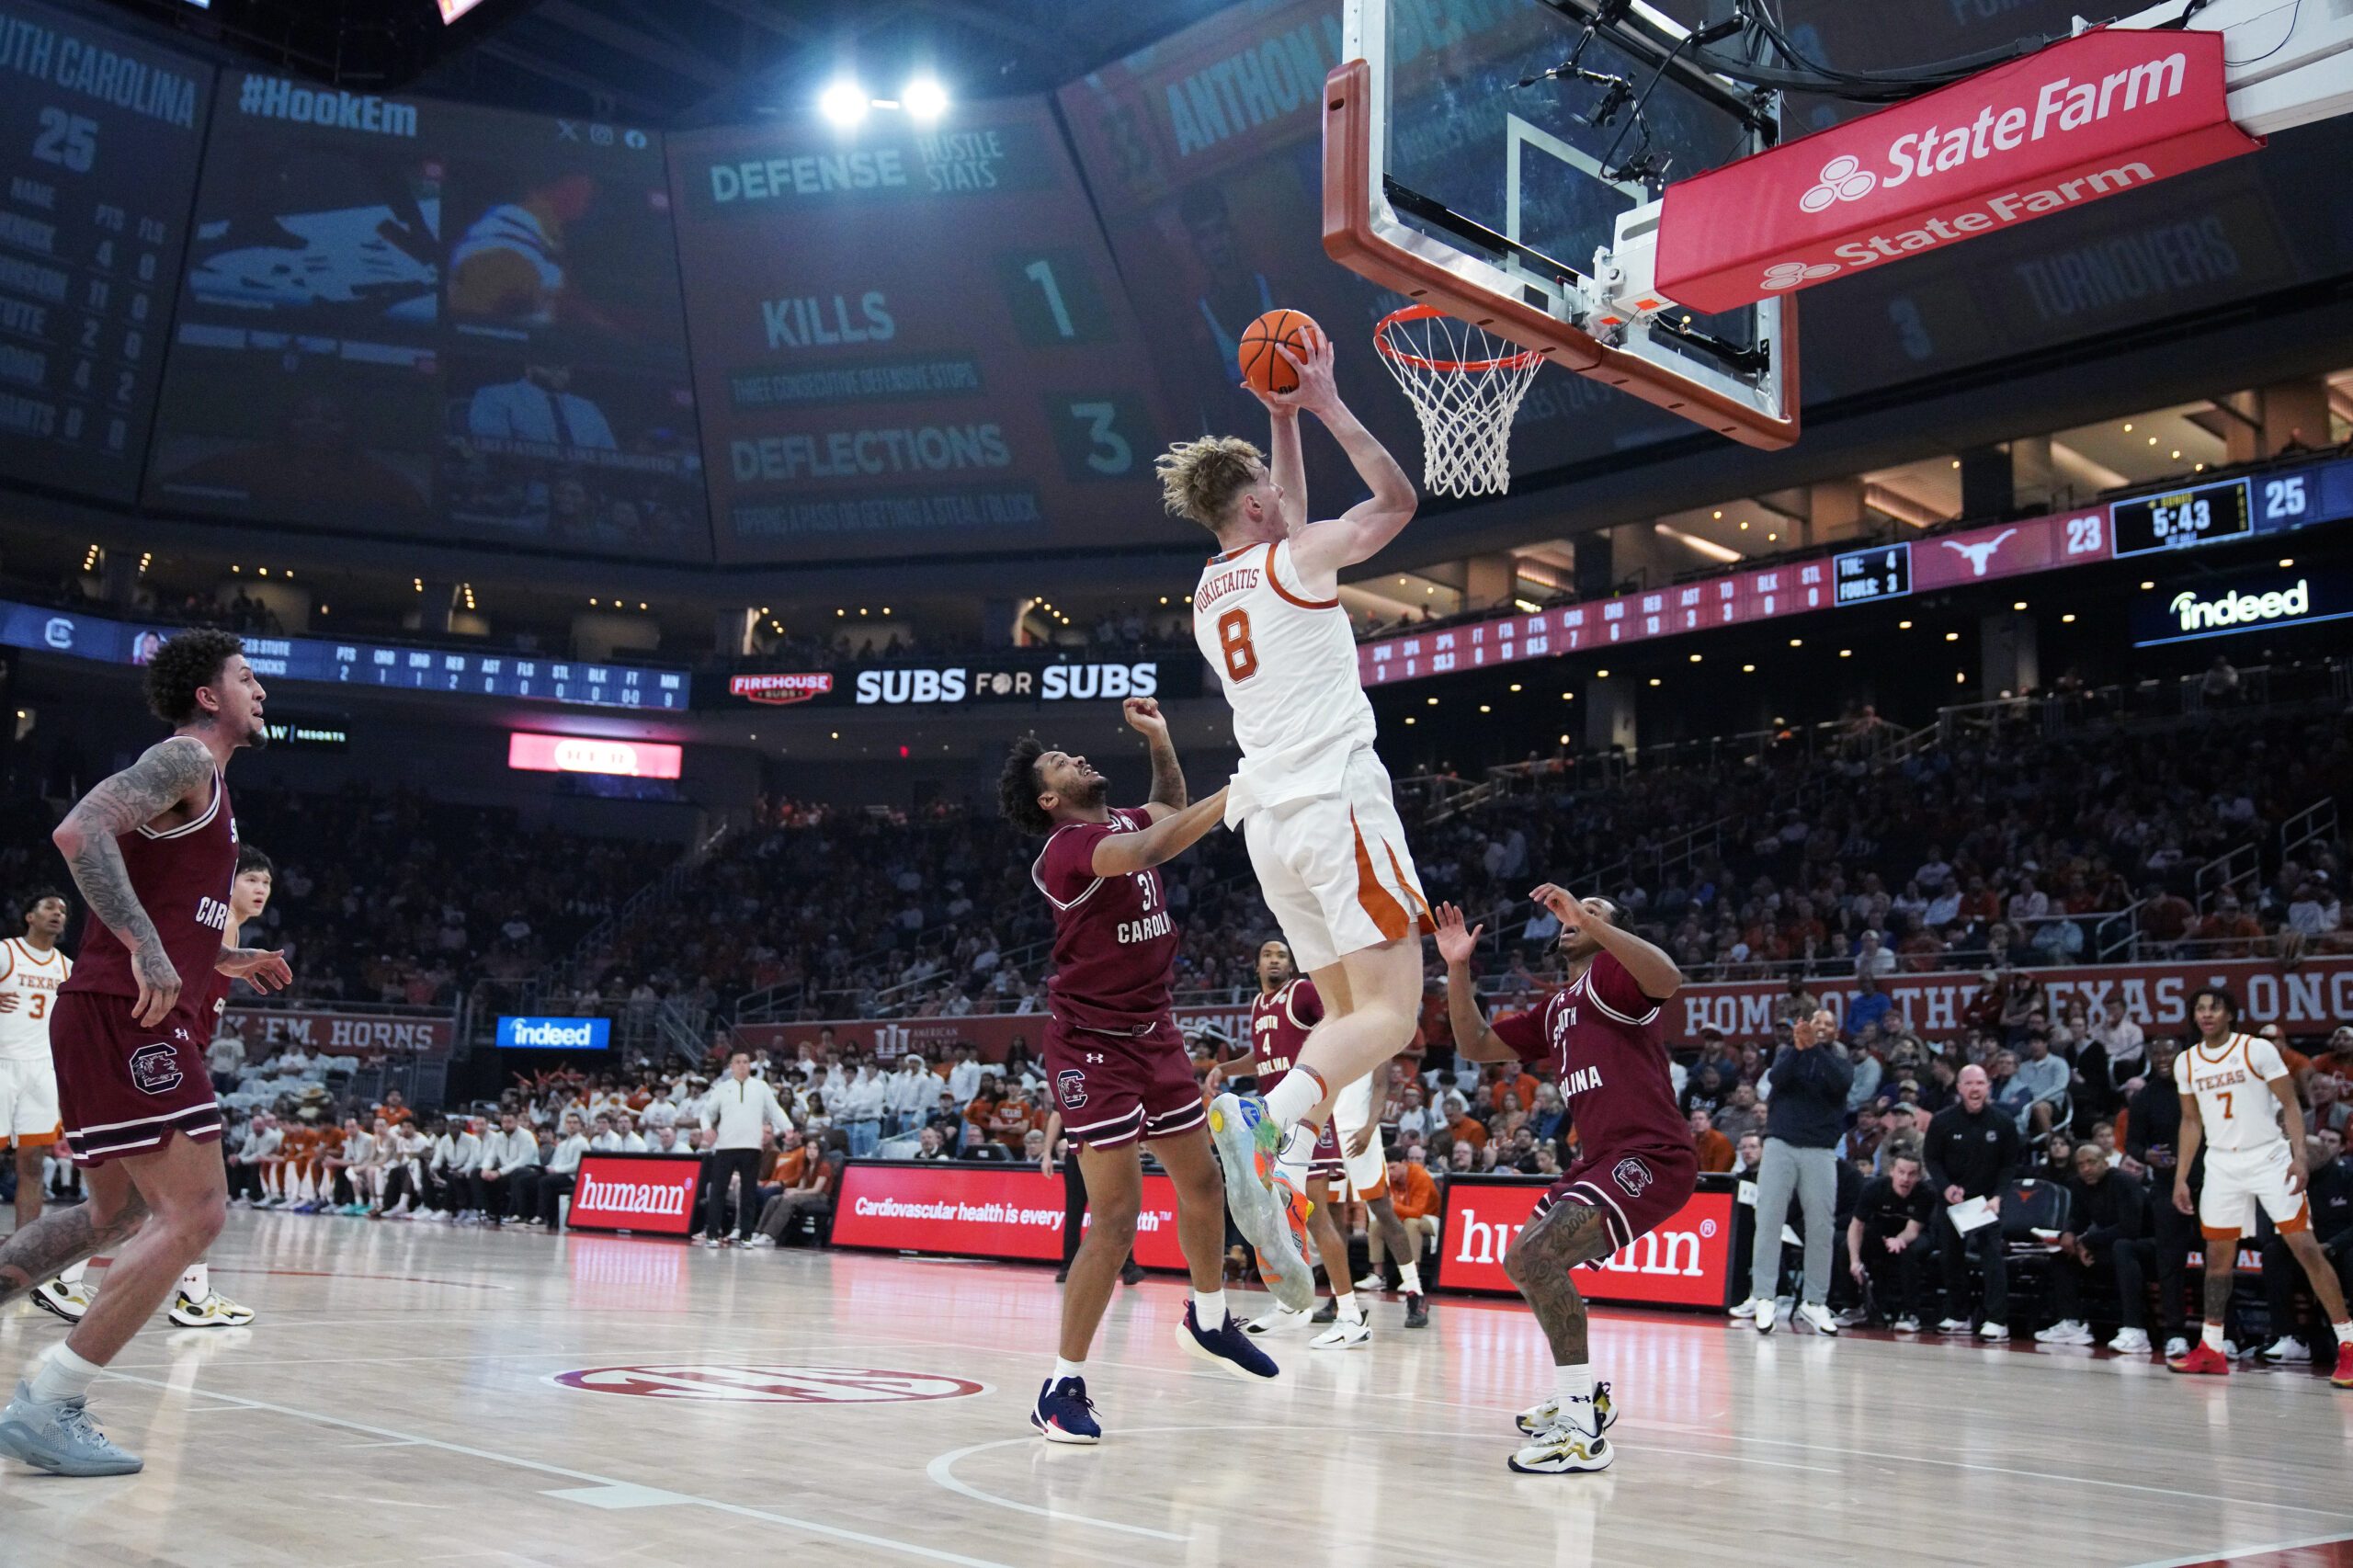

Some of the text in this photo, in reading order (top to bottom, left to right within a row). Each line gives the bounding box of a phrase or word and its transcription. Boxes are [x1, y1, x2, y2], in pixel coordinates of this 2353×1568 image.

[0, 14, 196, 130] UTH CAROLINA
[239, 73, 417, 138] #HookEm
[33, 106, 99, 173] 25
[922, 131, 1005, 166] HUSTLE
[710, 150, 907, 203] DEFENSE
[928, 160, 999, 191] STATS
[2015, 213, 2242, 319] TURNOVERS
[762, 258, 1076, 350] KILLS 1
[730, 401, 1133, 482] DEFLECTIONS 3
[2066, 516, 2102, 555] 23
[2152, 500, 2211, 538] 5:43
[2266, 476, 2306, 518] 25
[1195, 568, 1260, 614] VOKIETAITIS
[1681, 587, 1700, 607] AST
[1720, 582, 1733, 599] TO
[1757, 574, 1779, 593] BLK
[1802, 566, 1822, 585] STL
[1839, 574, 1898, 600] FOULS: 3
[2177, 579, 2309, 631] indeed
[1216, 607, 1259, 684] 8
[1570, 631, 1578, 649] 7
[336, 646, 357, 662] PTS
[481, 659, 500, 674] AST
[517, 662, 534, 677] FLS
[552, 665, 569, 680] STL
[588, 668, 607, 684] BLK
[626, 671, 639, 686] FT
[660, 674, 680, 689] MIN
[339, 665, 350, 682] 2
[380, 670, 385, 684] 1
[416, 672, 422, 687] 1
[449, 675, 459, 690] 2
[485, 677, 494, 693] 0
[520, 680, 529, 696] 0
[556, 683, 565, 699] 0
[592, 687, 601, 702] 0
[665, 692, 674, 708] 9
[734, 675, 829, 693] FIREHOUSE
[856, 667, 967, 705] SUBS
[1041, 662, 1158, 700] SUBS
[1137, 870, 1158, 910] 31
[28, 994, 46, 1019] 3
[1255, 1015, 1279, 1035] SOUTH
[330, 1019, 434, 1051] HORNS
[514, 1019, 592, 1046] indeed
[1262, 1032, 1272, 1056] 4
[2195, 1069, 2246, 1092] TEXAS
[2216, 1093, 2234, 1119] 7
[577, 1173, 684, 1215] humann
[855, 1197, 958, 1221] Cardiovascular
[958, 1202, 1005, 1223] health
[1005, 1203, 1019, 1222] is
